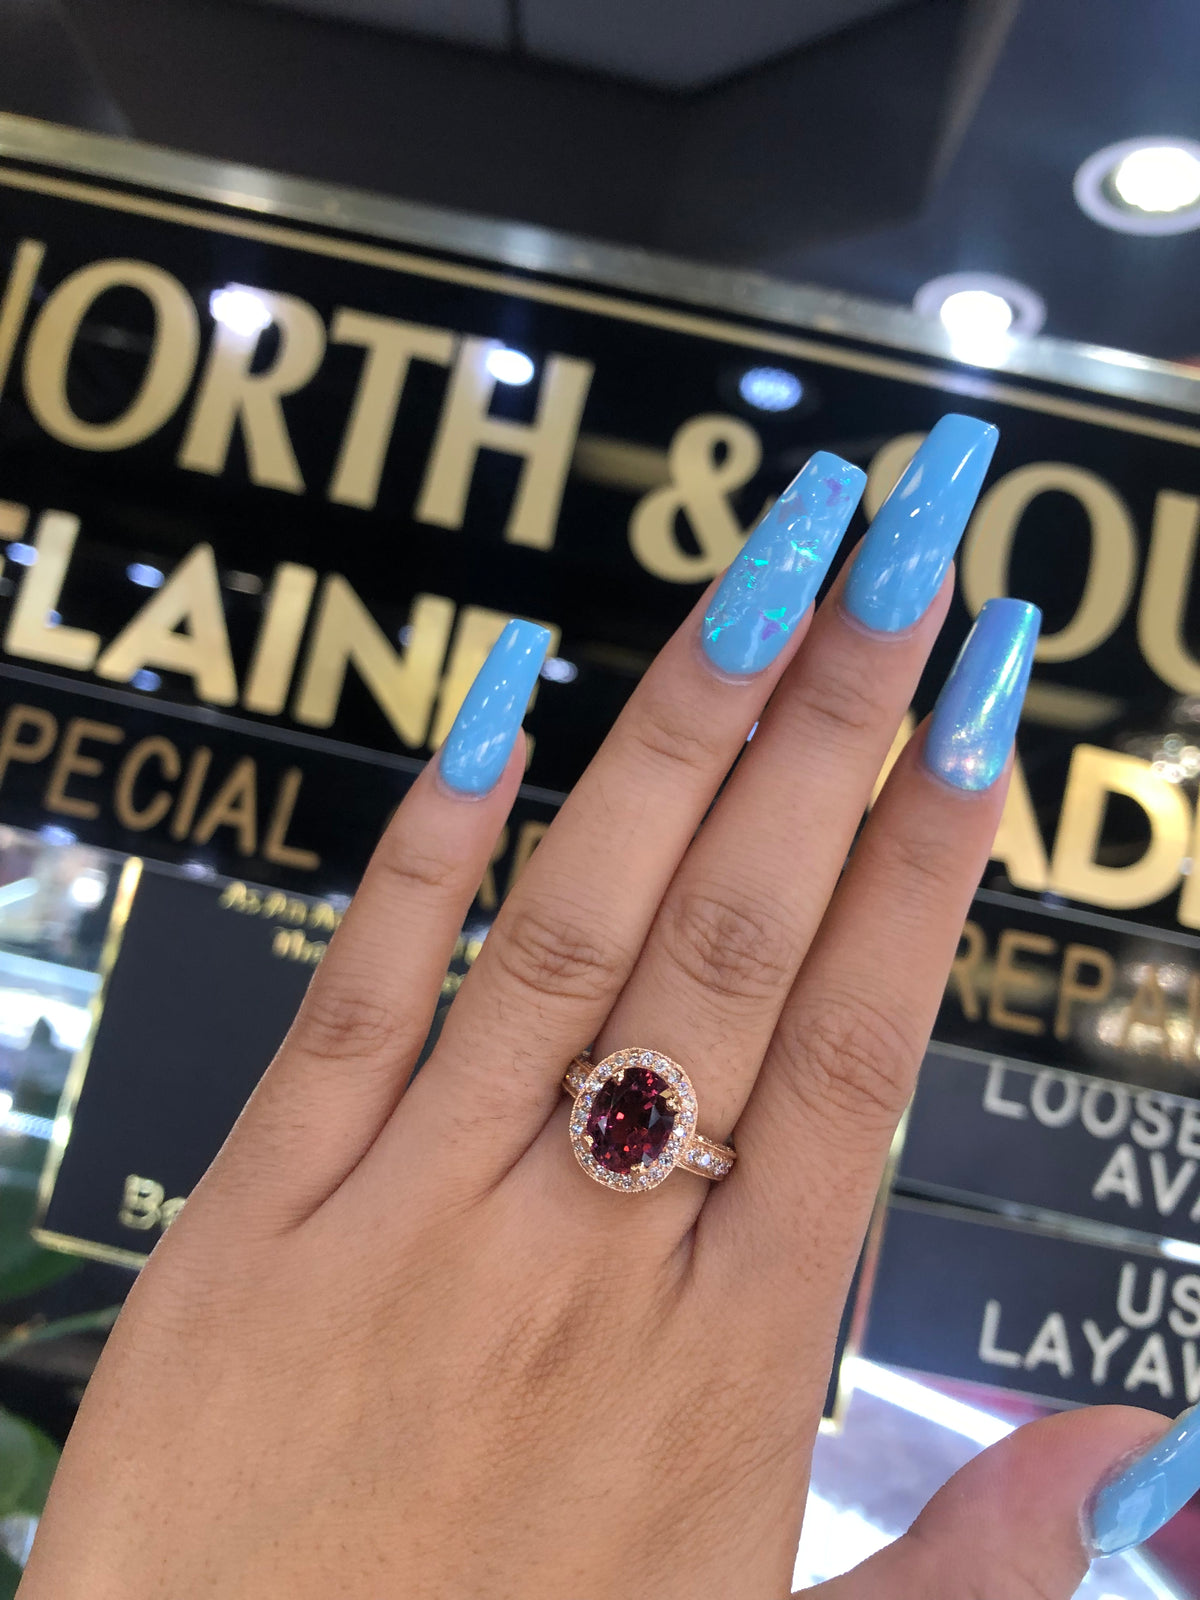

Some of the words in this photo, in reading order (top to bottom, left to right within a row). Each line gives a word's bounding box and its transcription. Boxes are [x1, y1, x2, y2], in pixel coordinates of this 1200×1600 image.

[627, 414, 775, 584] &
[0, 702, 321, 872] PECIAL
[1091, 1142, 1200, 1224] AV
